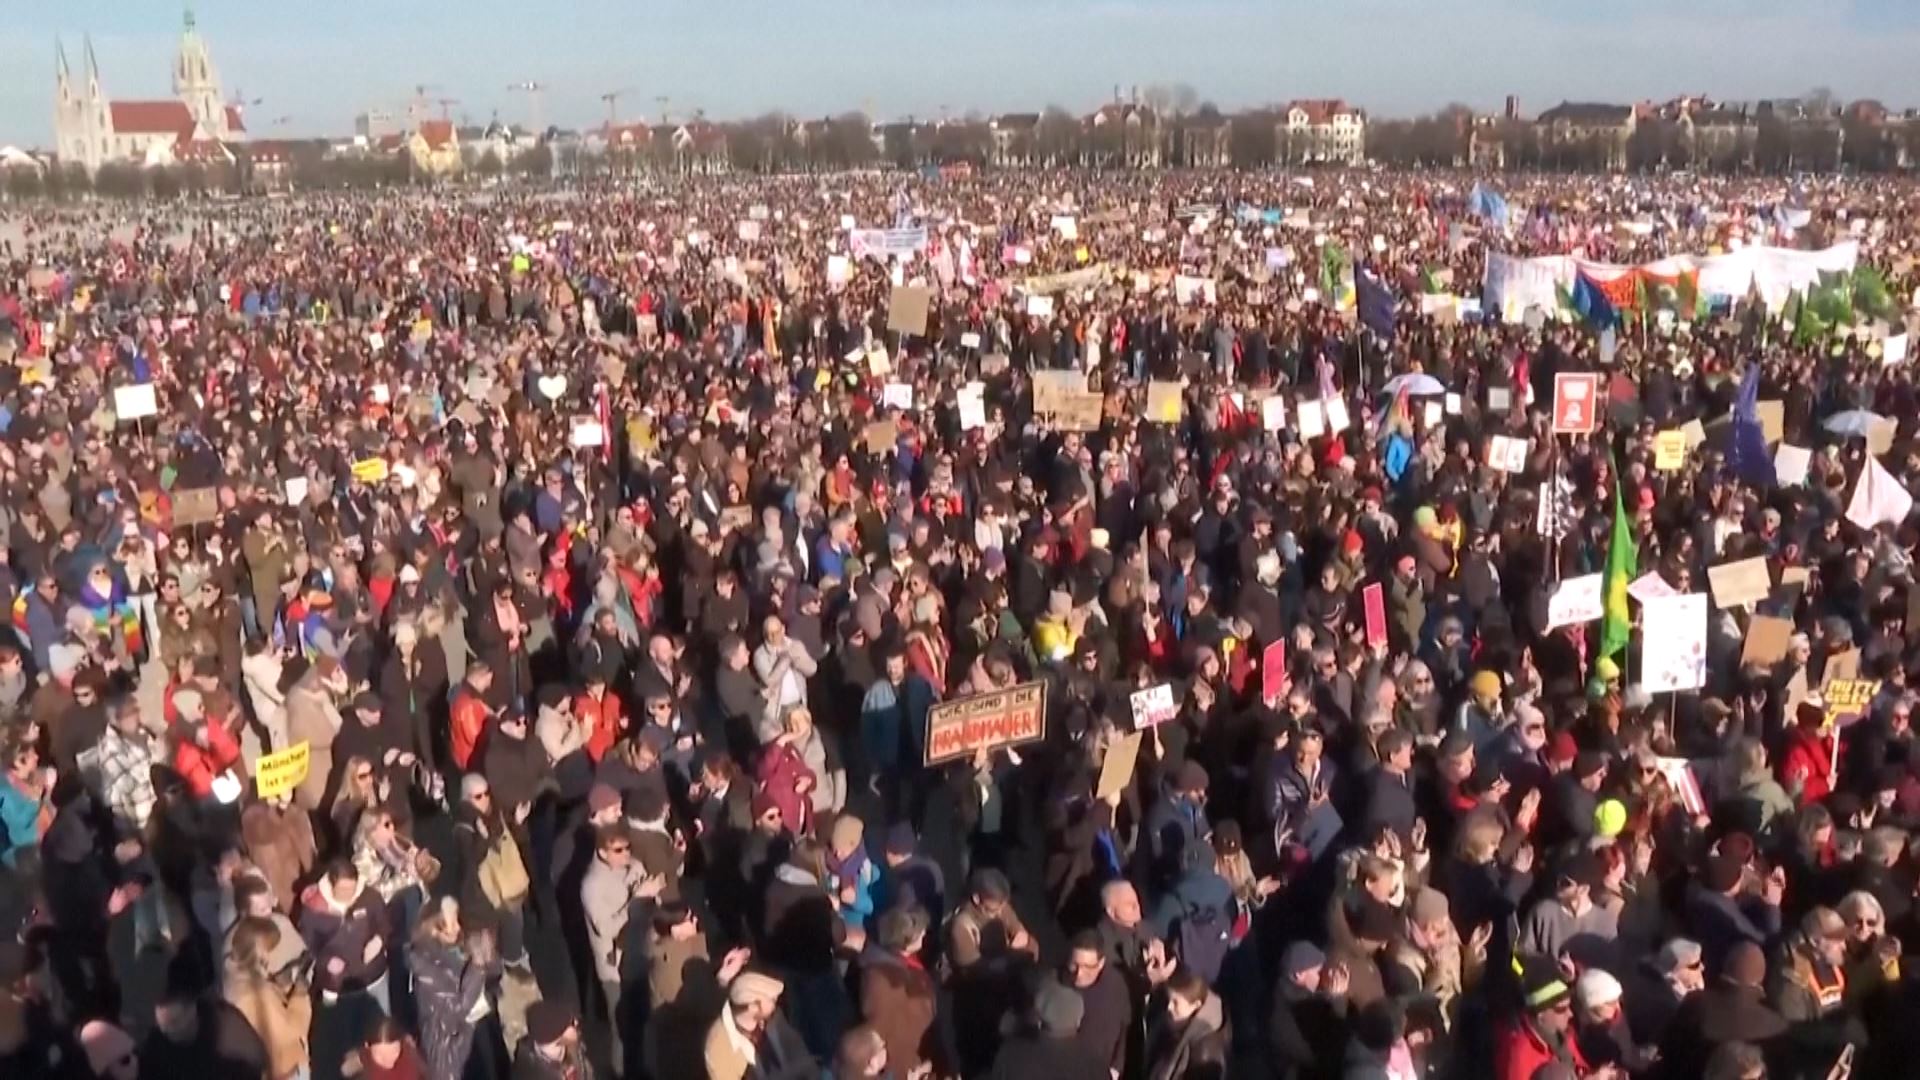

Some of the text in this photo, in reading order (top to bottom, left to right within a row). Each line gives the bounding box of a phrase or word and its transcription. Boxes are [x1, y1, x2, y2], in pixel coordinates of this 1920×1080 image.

[938, 689, 1033, 720] WIR SIND DIE
